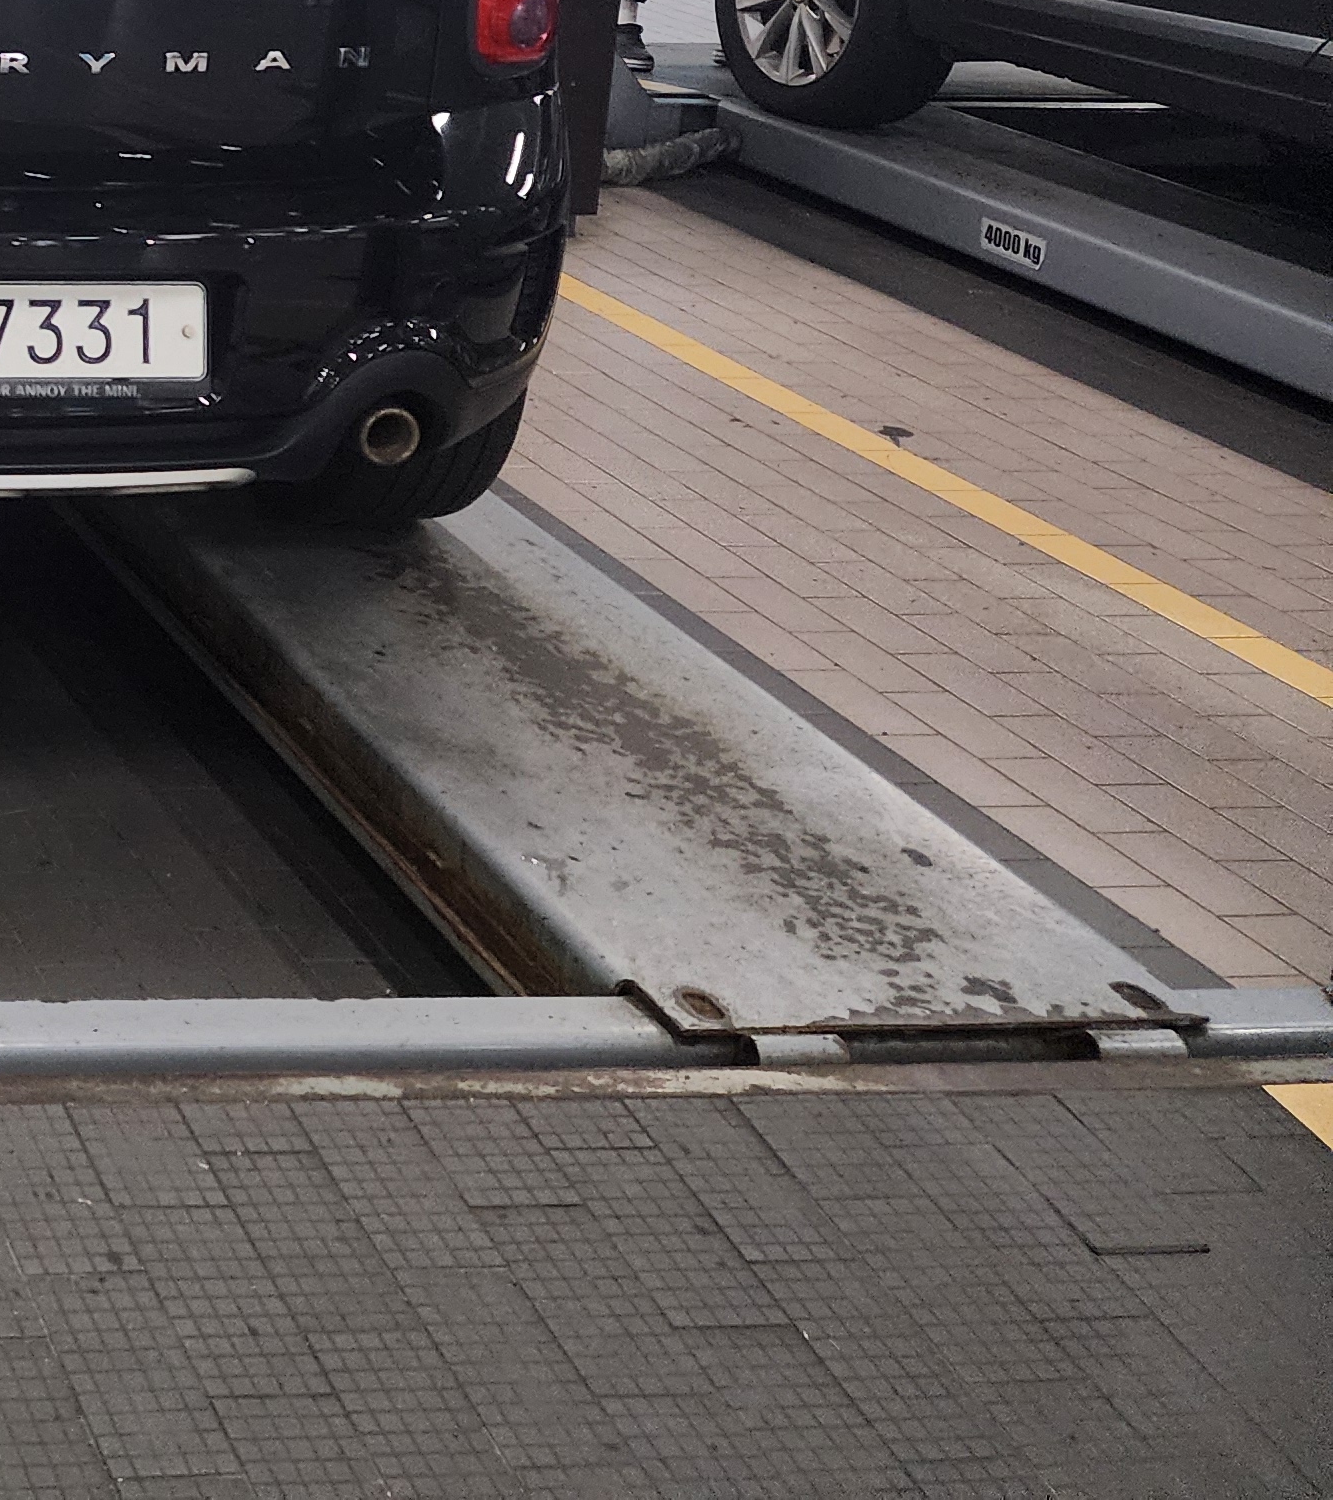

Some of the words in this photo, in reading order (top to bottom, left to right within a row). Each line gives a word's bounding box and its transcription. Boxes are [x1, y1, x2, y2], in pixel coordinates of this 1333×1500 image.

[985, 224, 1021, 256] 4000
[1023, 238, 1043, 266] kg
[15, 383, 67, 398] ANNOY
[72, 383, 100, 398] THE
